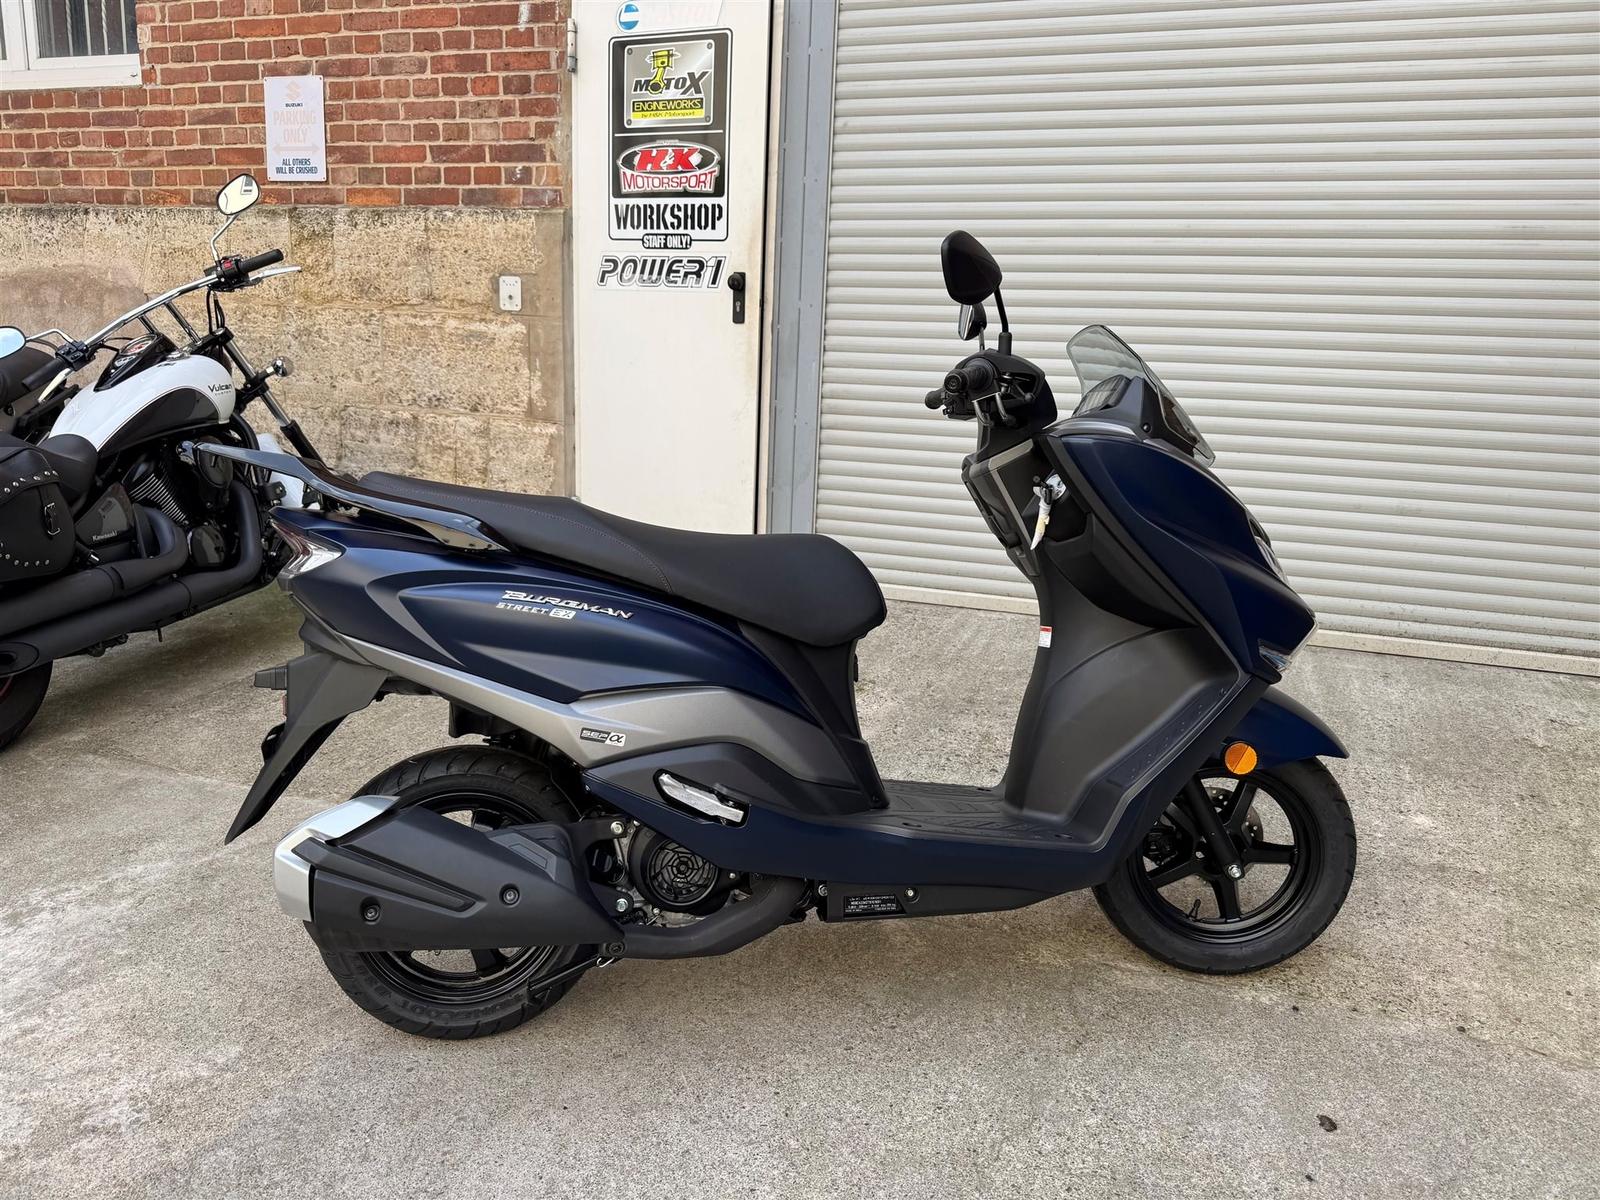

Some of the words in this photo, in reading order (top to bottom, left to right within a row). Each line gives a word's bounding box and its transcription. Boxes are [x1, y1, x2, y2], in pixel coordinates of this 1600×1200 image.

[634, 100, 701, 112] ENGINEWORKS
[274, 110, 317, 124] PARKING
[284, 128, 308, 144] ONLY
[282, 158, 291, 166] ALL
[293, 158, 311, 166] OTHERS
[288, 167, 295, 175] BE
[296, 166, 318, 174] CRUSHED
[622, 169, 717, 190] MOTORSPORT
[614, 203, 723, 230] WORKSHOP
[643, 235, 666, 248] STAFF
[667, 235, 690, 248] ONLY!
[208, 383, 232, 392] Vulcan
[496, 602, 549, 614] STREET
[502, 590, 633, 619] BURGMAN
